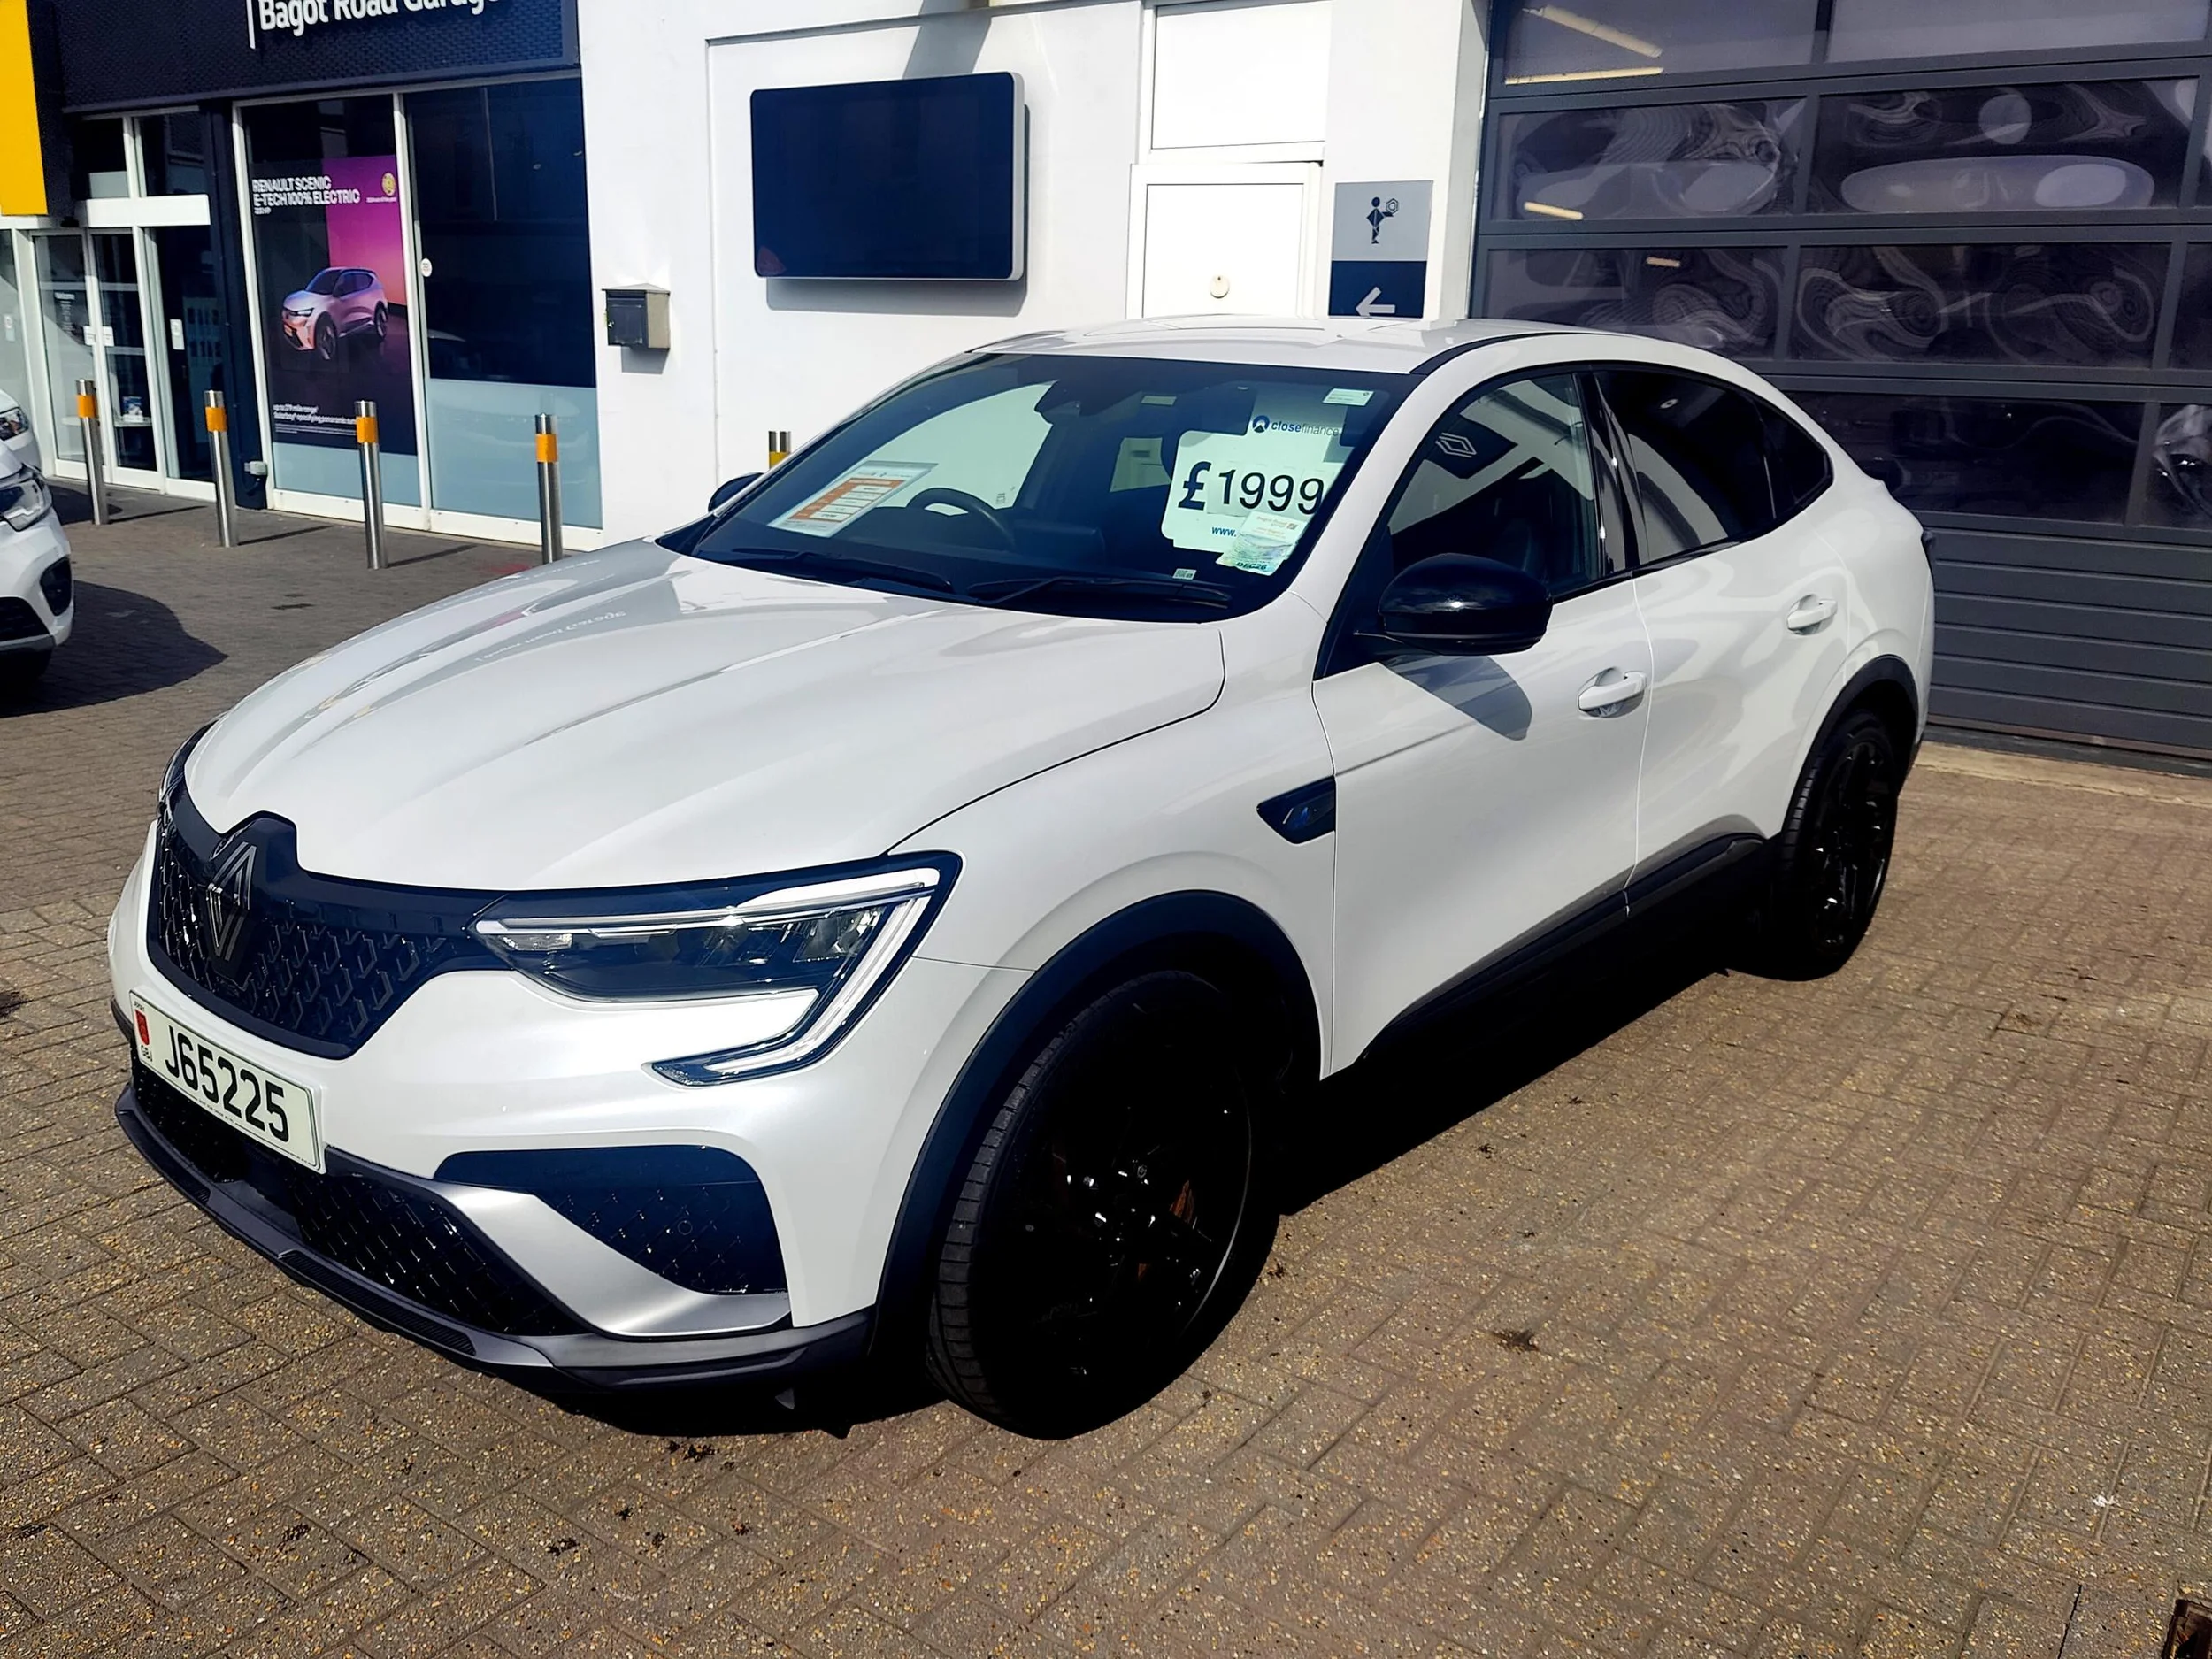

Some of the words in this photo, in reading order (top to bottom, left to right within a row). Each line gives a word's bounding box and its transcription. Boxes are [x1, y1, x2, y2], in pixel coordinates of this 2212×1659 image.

[260, 0, 328, 36] Bagot
[251, 178, 295, 192] RENAULT
[295, 175, 332, 191] SCENIC
[253, 192, 288, 207] E-TECH
[288, 190, 312, 205] 100%
[312, 188, 361, 205] ELECTRIC
[165, 1025, 290, 1143] J65225
